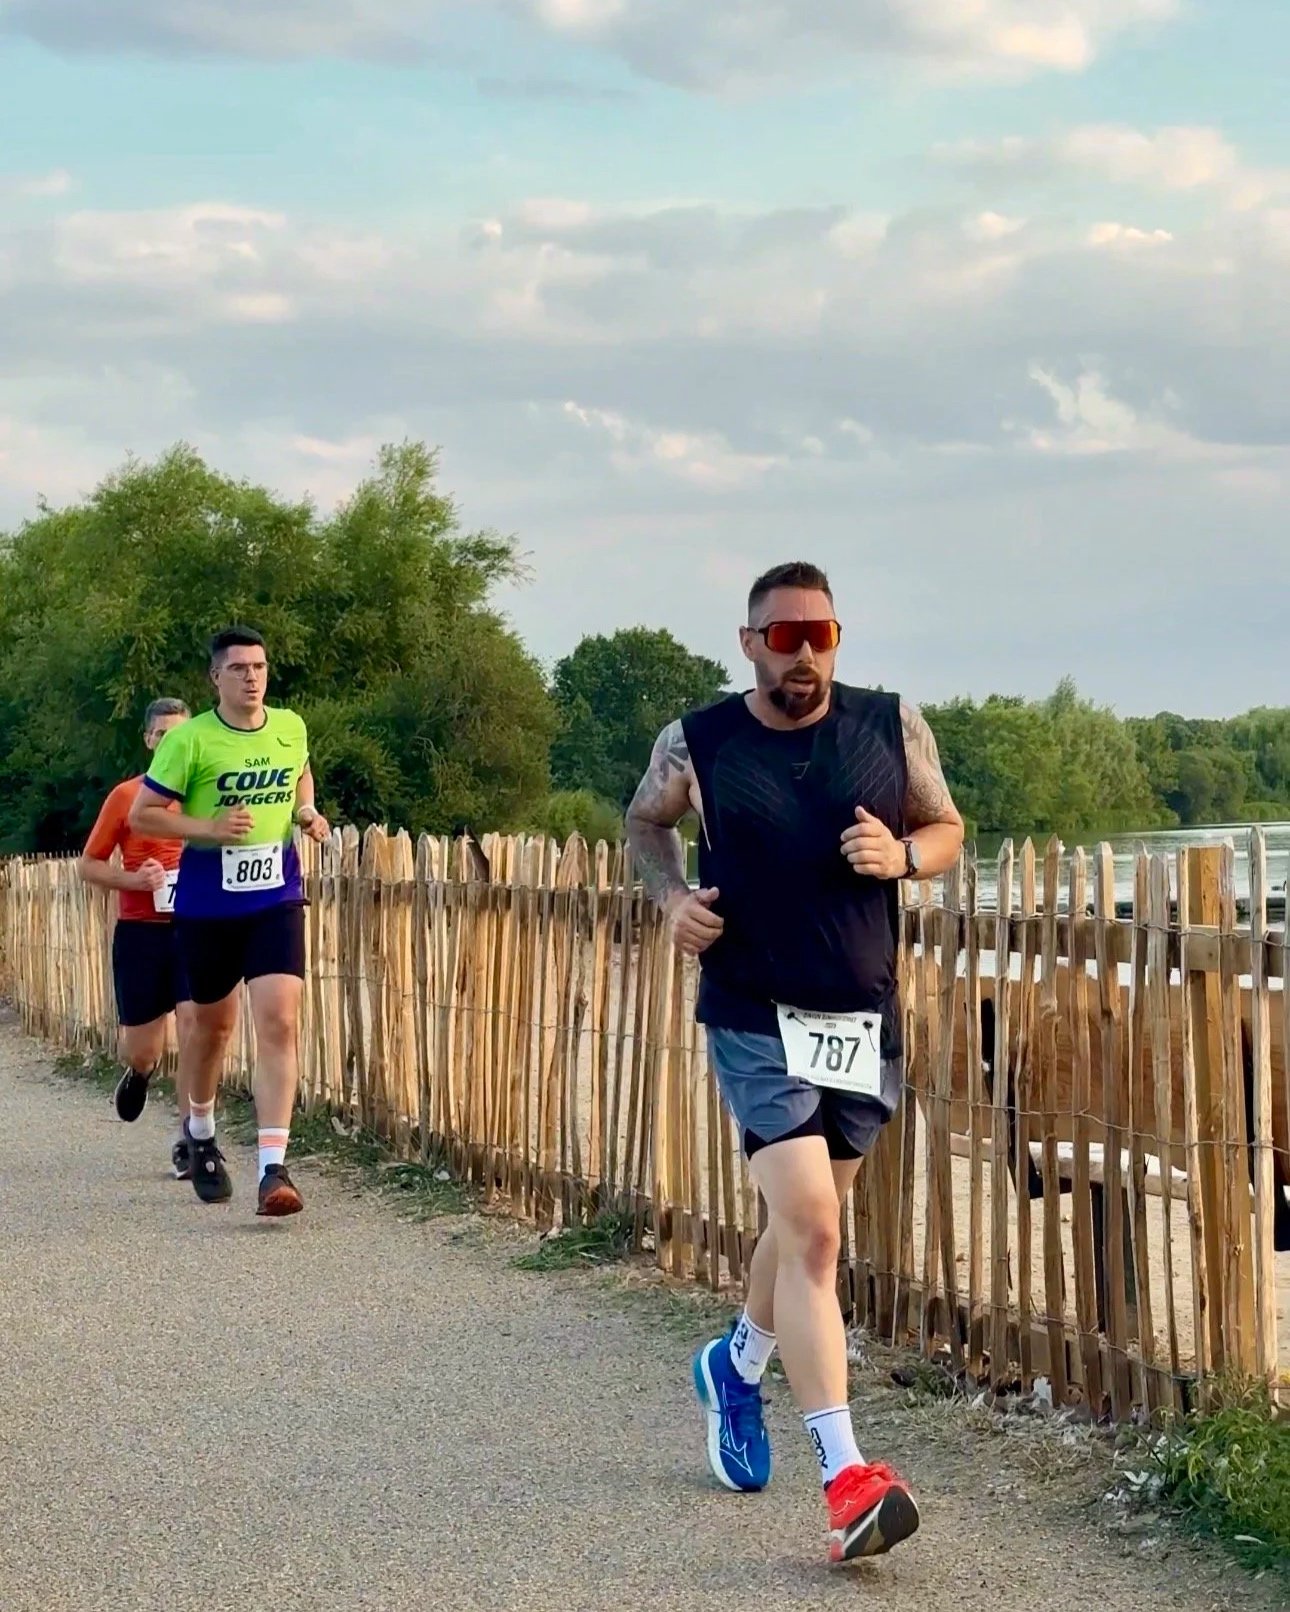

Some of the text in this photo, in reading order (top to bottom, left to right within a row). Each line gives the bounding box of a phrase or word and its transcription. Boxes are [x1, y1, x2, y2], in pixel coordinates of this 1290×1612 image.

[244, 757, 271, 768] SAM
[214, 790, 294, 807] JOGGERS
[236, 857, 273, 883] 803
[808, 1031, 861, 1074] 787
